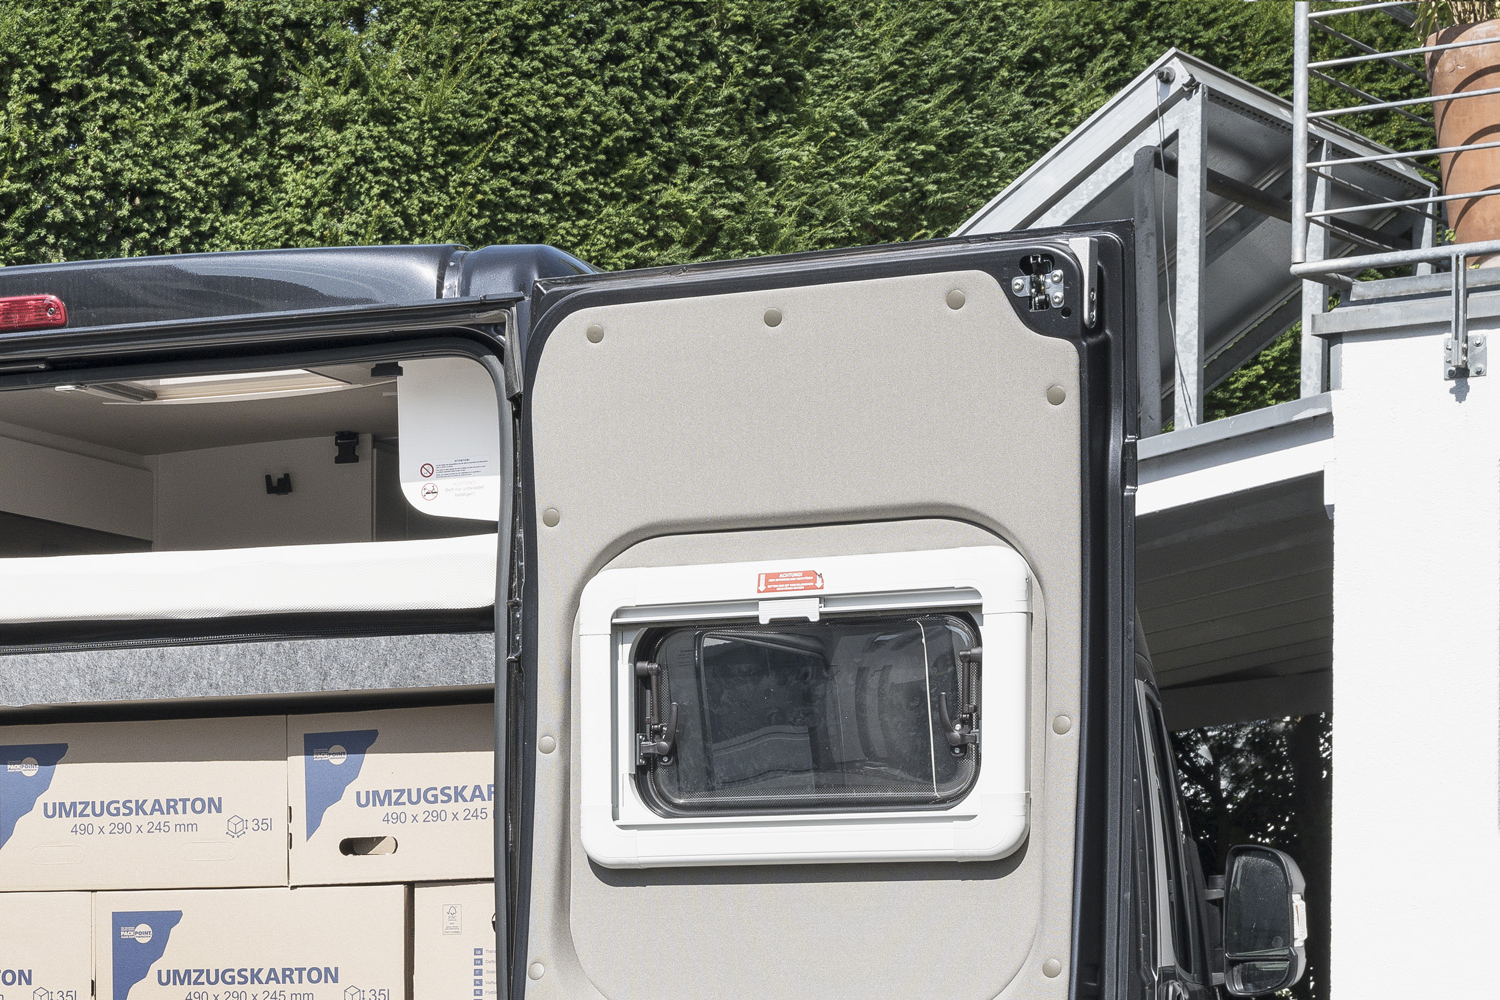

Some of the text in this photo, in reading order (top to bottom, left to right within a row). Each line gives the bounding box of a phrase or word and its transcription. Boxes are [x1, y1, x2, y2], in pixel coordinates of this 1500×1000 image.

[43, 797, 222, 819] UMZUGSKARTON
[383, 808, 487, 825] 490 x 290 x 245
[71, 821, 197, 835] 490 x 290 x 245 mm
[158, 967, 338, 986] UMZUGSKARTON
[291, 993, 313, 1000] mm
